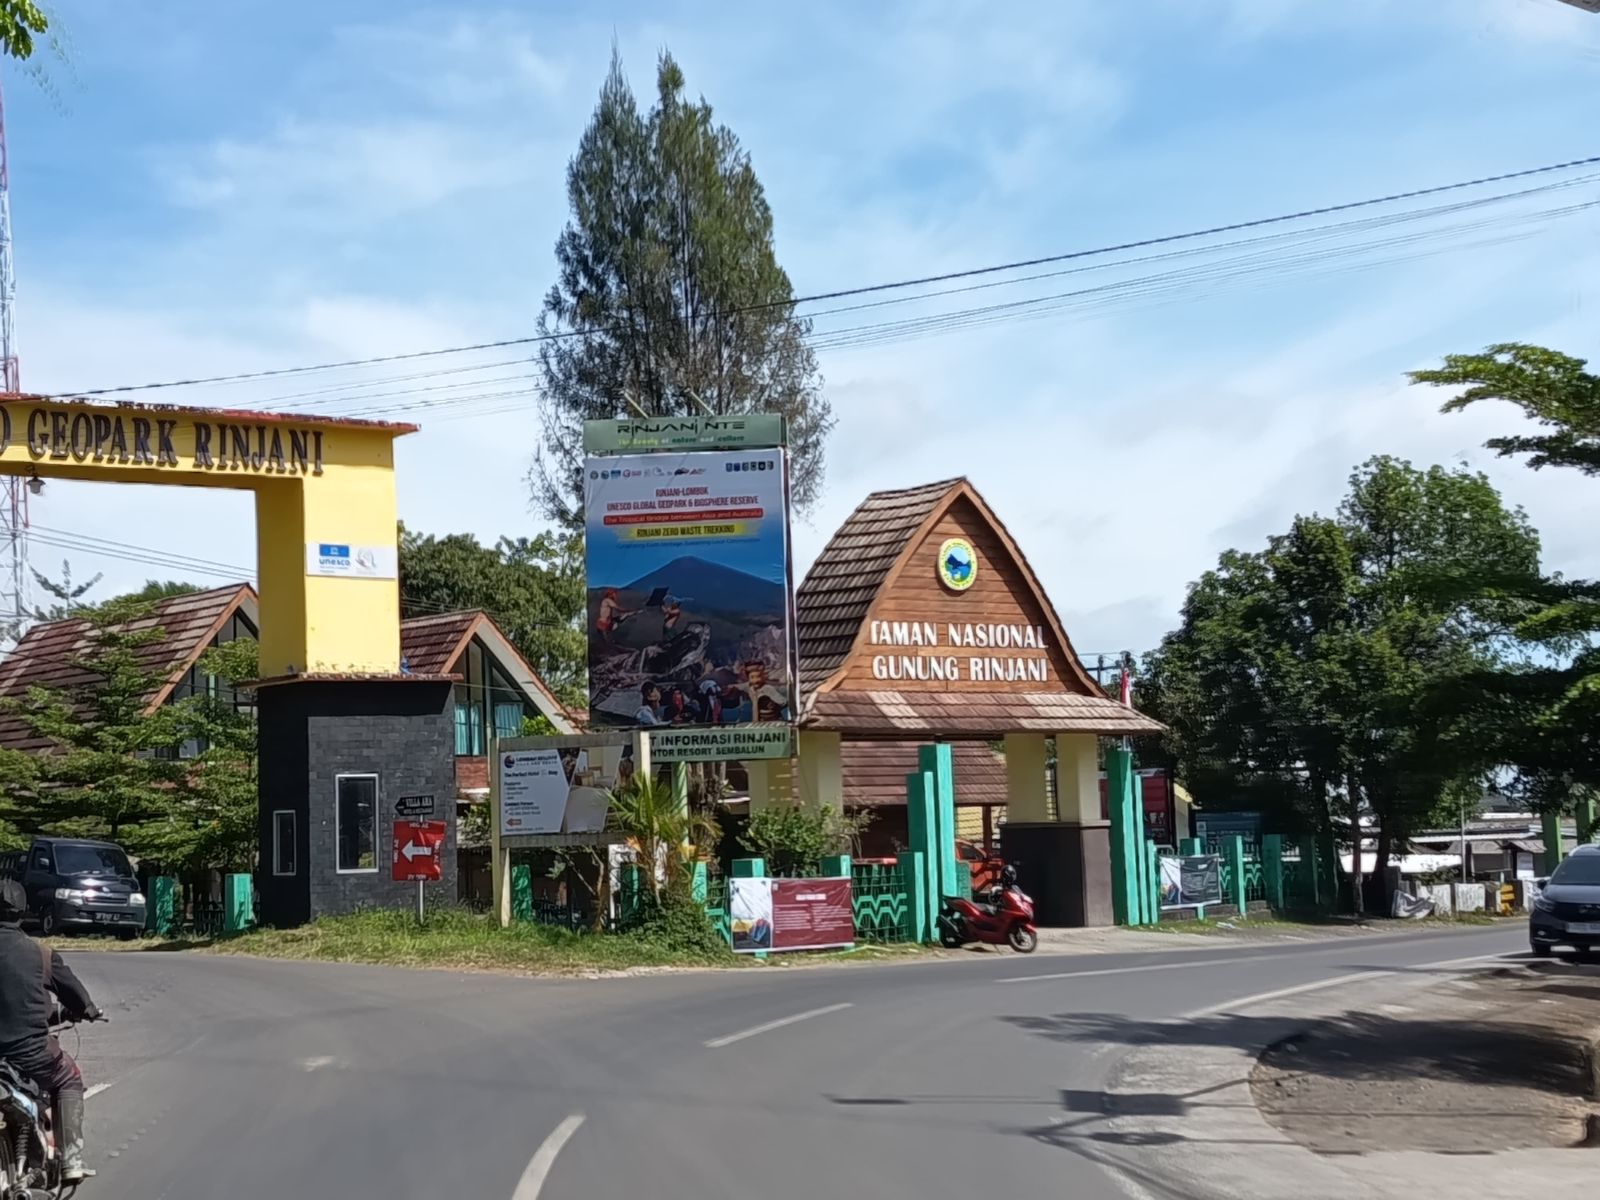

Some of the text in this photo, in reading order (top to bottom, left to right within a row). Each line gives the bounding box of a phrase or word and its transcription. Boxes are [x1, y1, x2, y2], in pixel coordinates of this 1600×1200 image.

[27, 408, 178, 467] GEOPARK
[193, 421, 324, 476] RINJANI
[607, 502, 632, 511] UNESCO
[633, 500, 657, 510] GLOBAL
[658, 499, 687, 509] GEOPARK
[694, 497, 729, 507] BIOSPHERE
[730, 495, 759, 505] RESERVE
[637, 524, 735, 538] RINJANI ZERO WASTE TREKKING
[319, 558, 350, 567] unesco
[870, 620, 1049, 649] TAMAN NASIONAL
[872, 655, 1048, 682] GUNUNG RINJANI
[661, 733, 731, 746] INFORMASI
[734, 732, 786, 743] RINJANI
[677, 747, 713, 757] RESORT
[715, 745, 765, 755] SEMBALUN
